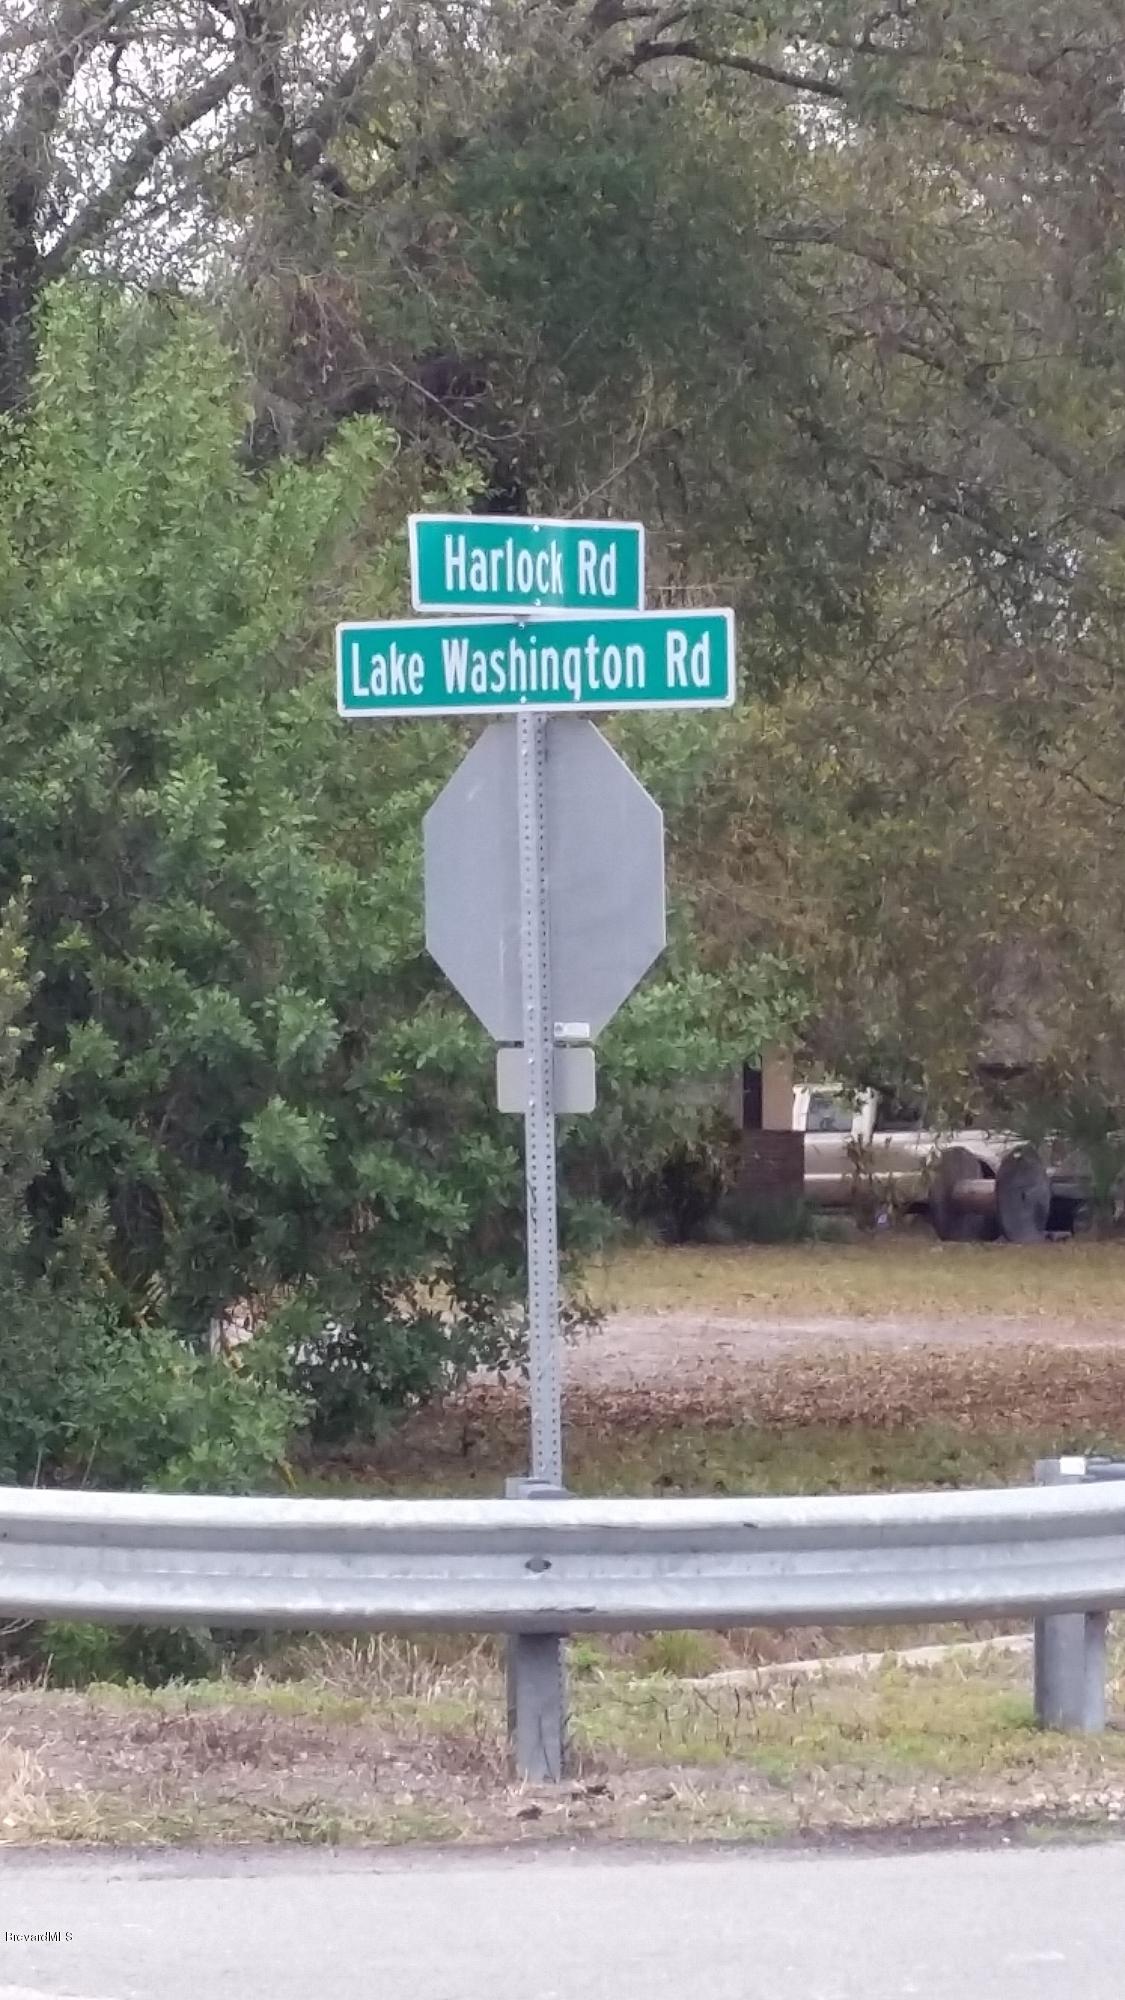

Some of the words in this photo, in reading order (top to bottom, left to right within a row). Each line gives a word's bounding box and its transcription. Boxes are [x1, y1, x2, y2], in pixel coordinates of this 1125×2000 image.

[444, 534, 563, 594] Harlock
[577, 539, 617, 596] Rd
[351, 641, 424, 697] Lake
[442, 634, 646, 702] Washington
[666, 630, 711, 688] Rd
